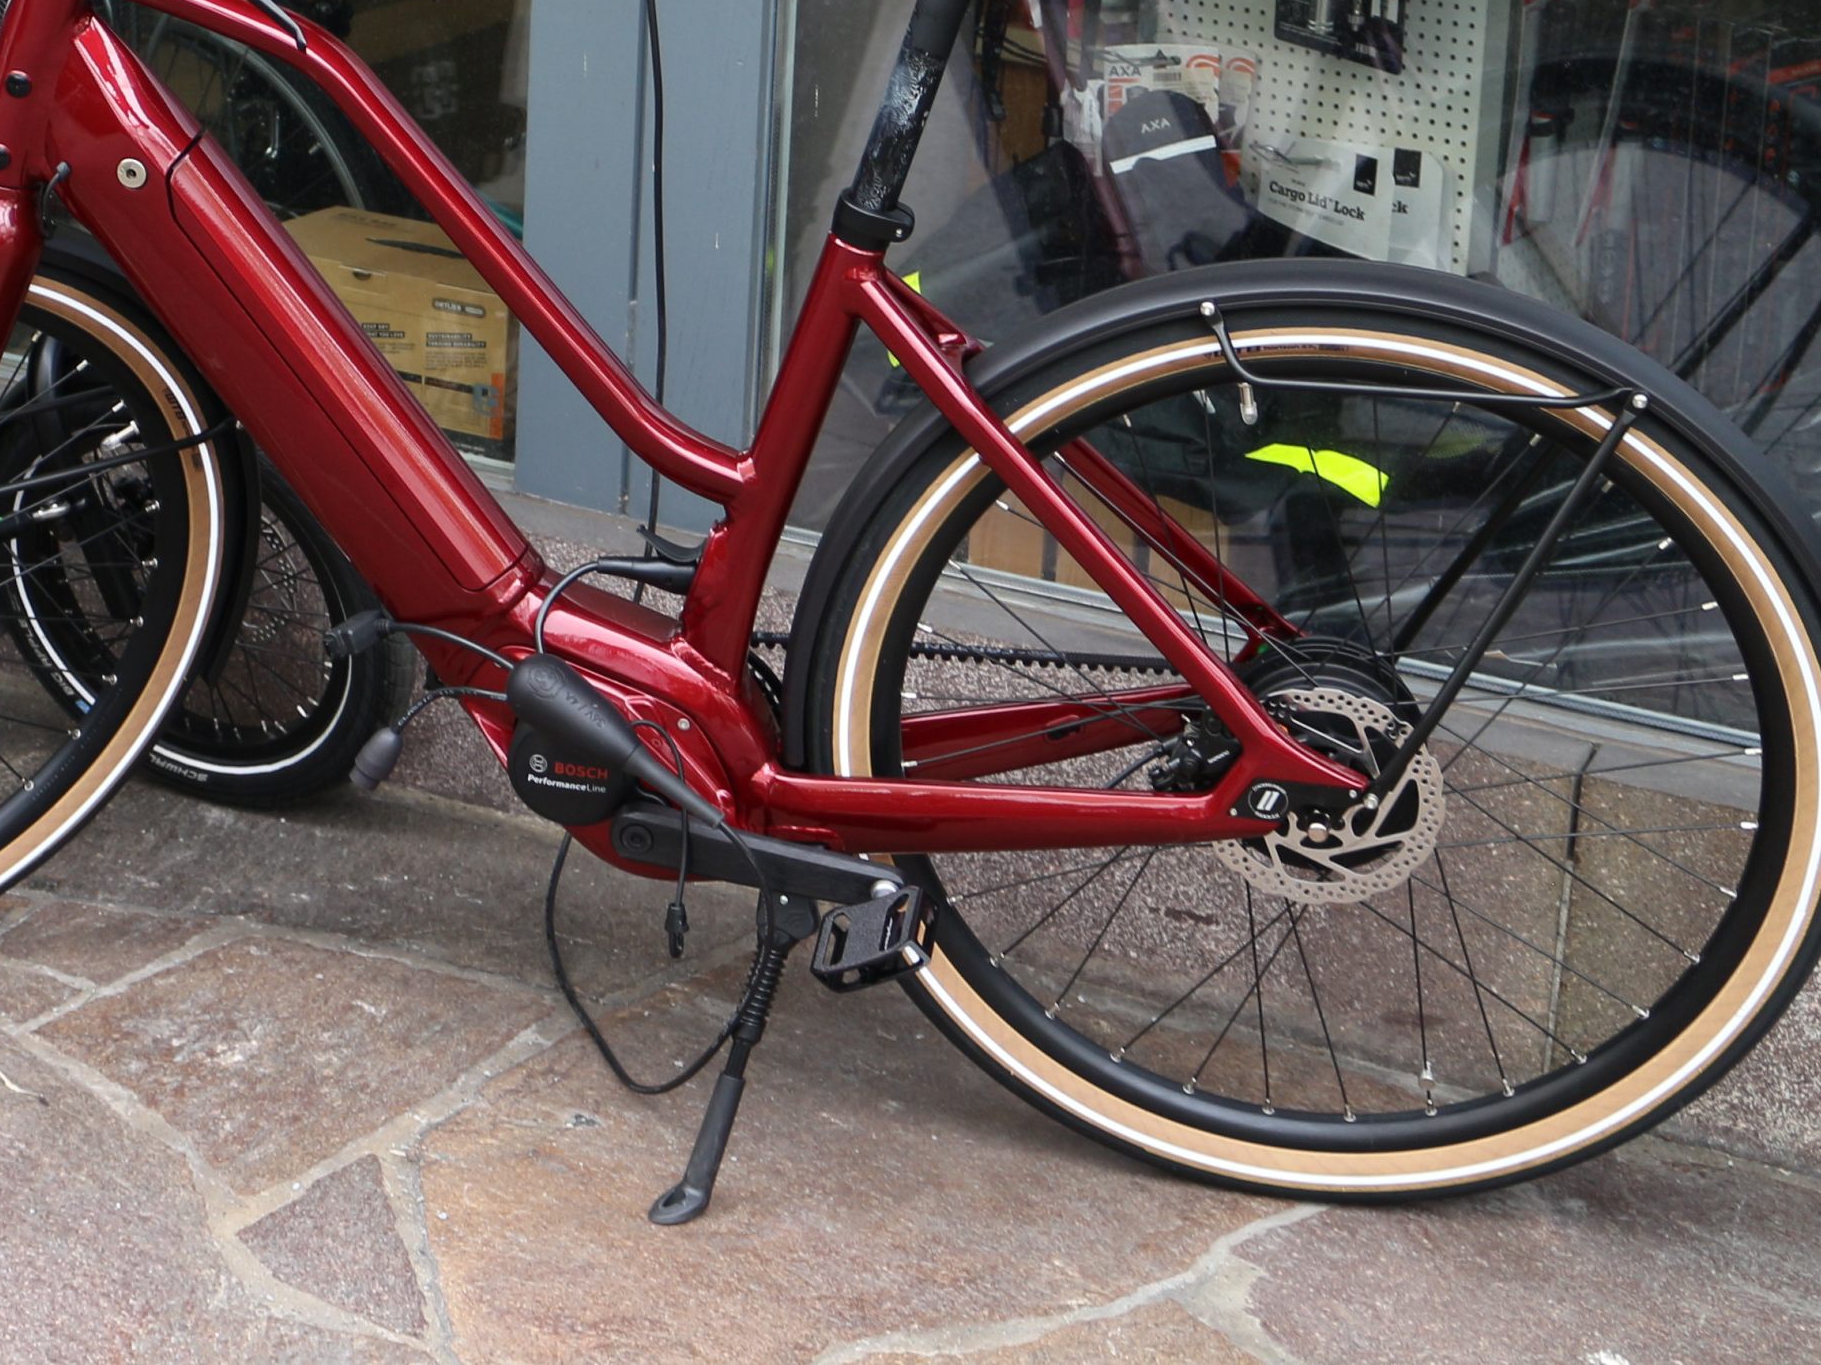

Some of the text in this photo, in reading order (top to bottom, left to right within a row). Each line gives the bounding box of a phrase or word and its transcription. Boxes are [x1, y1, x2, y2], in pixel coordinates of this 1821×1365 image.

[1109, 65, 1141, 76] AXA
[1141, 117, 1170, 134] AXA
[1270, 181, 1306, 202] Cargo
[1333, 199, 1365, 221] Lock
[554, 761, 608, 779] BOSCH
[527, 773, 606, 793] PerformanceLine
